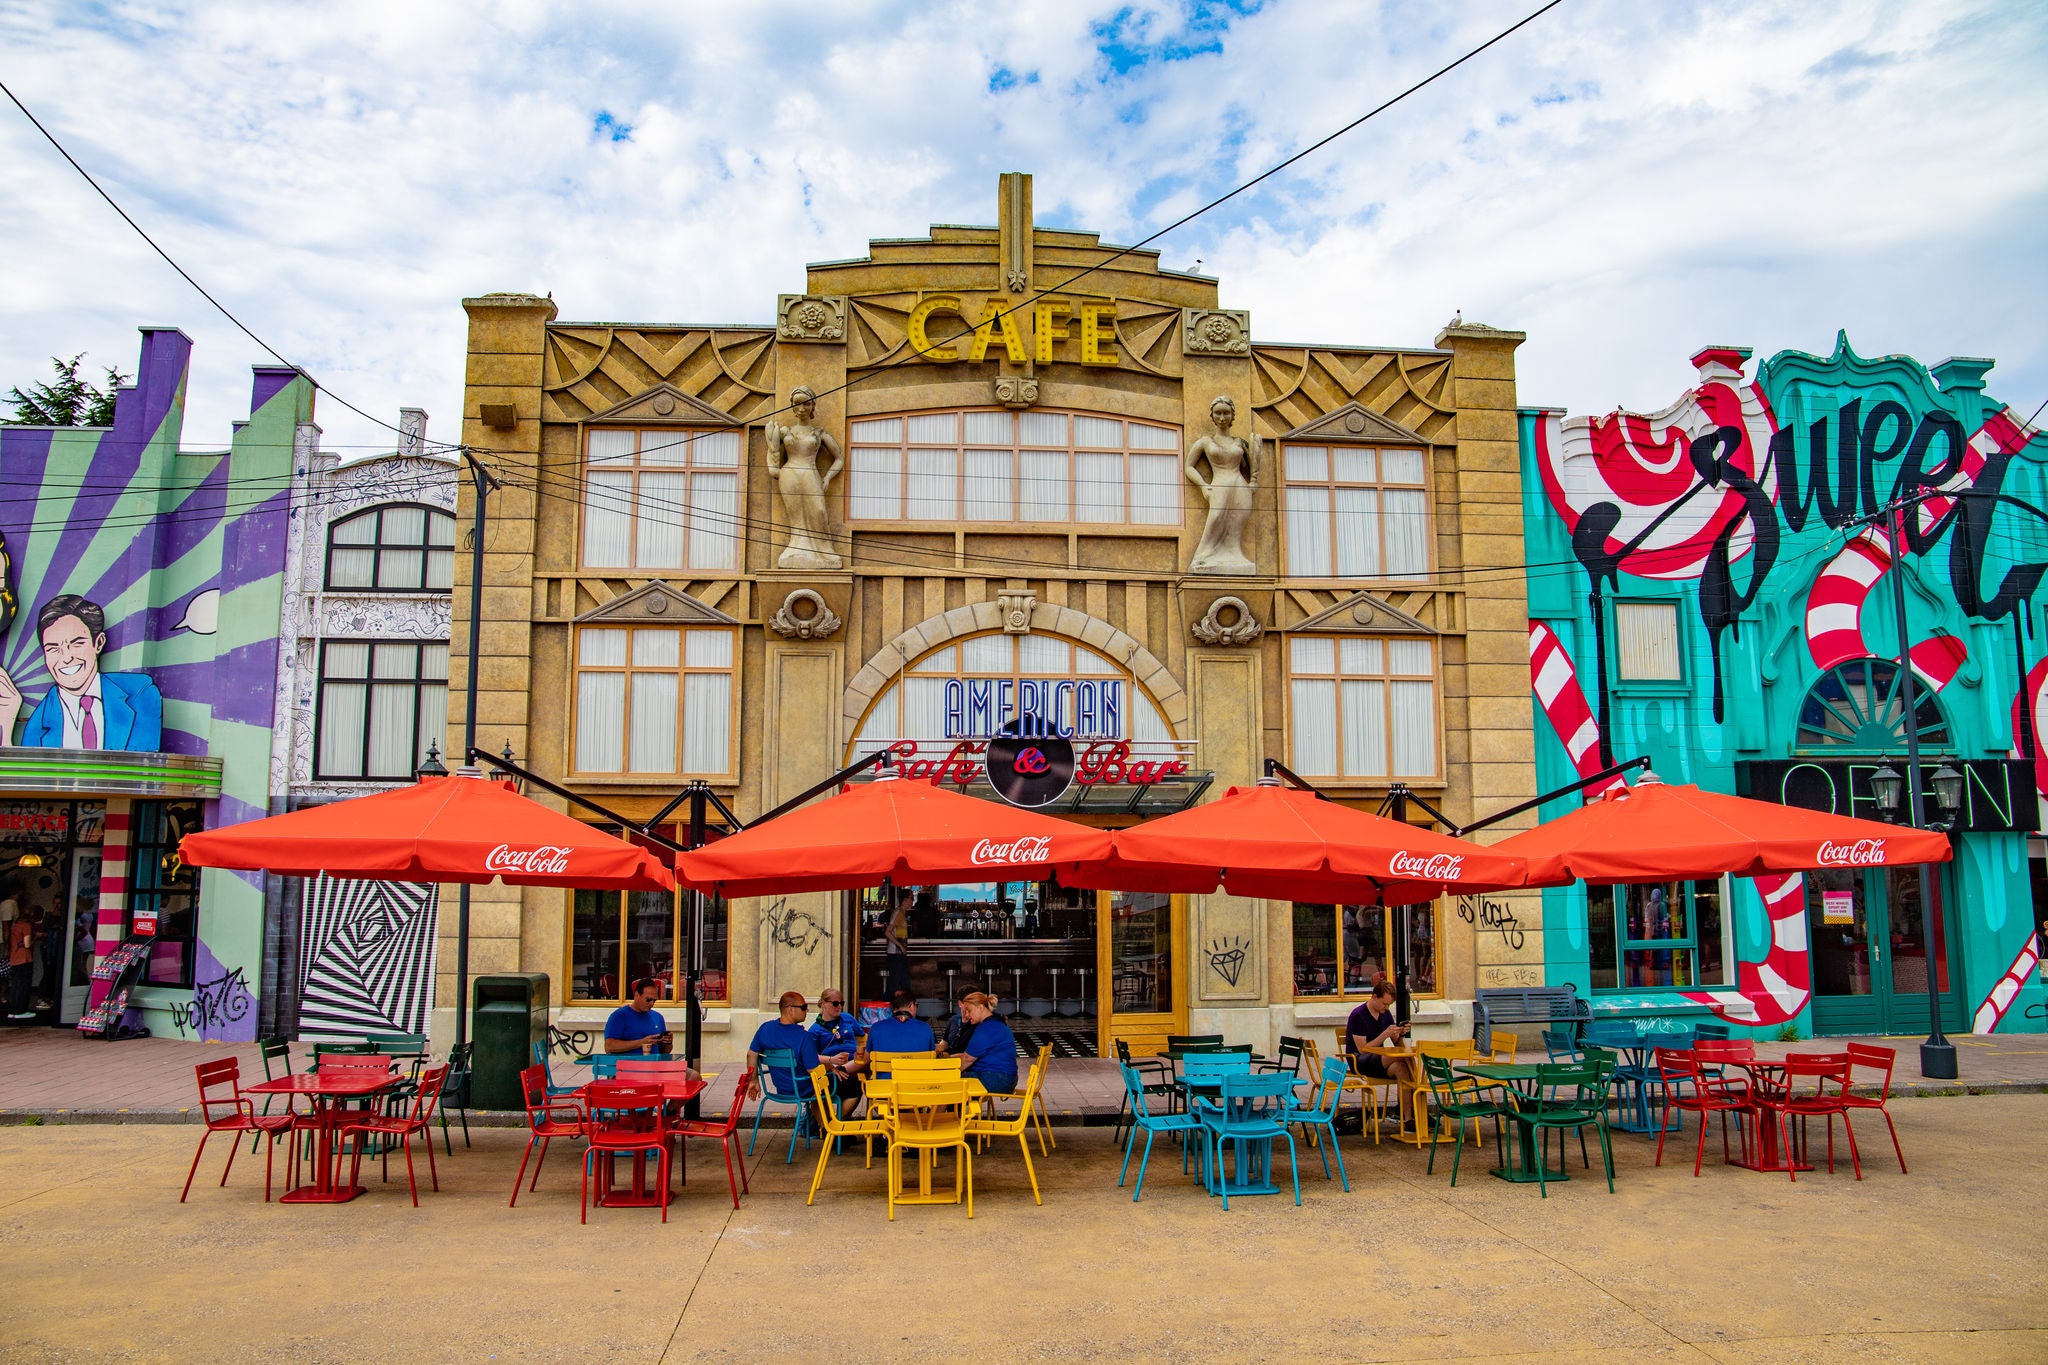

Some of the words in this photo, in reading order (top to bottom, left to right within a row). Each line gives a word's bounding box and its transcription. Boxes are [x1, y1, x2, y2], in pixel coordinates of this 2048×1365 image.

[907, 294, 1121, 367] CAFE
[944, 679, 1121, 739] AMERICAN
[1013, 747, 1051, 774] &
[1075, 738, 1188, 785] Bar
[485, 844, 575, 873] Coca-Cola
[970, 836, 1054, 865] Coca-Cola
[1389, 850, 1466, 880] Coca-Cola
[1817, 839, 1886, 865] Coca-Cola
